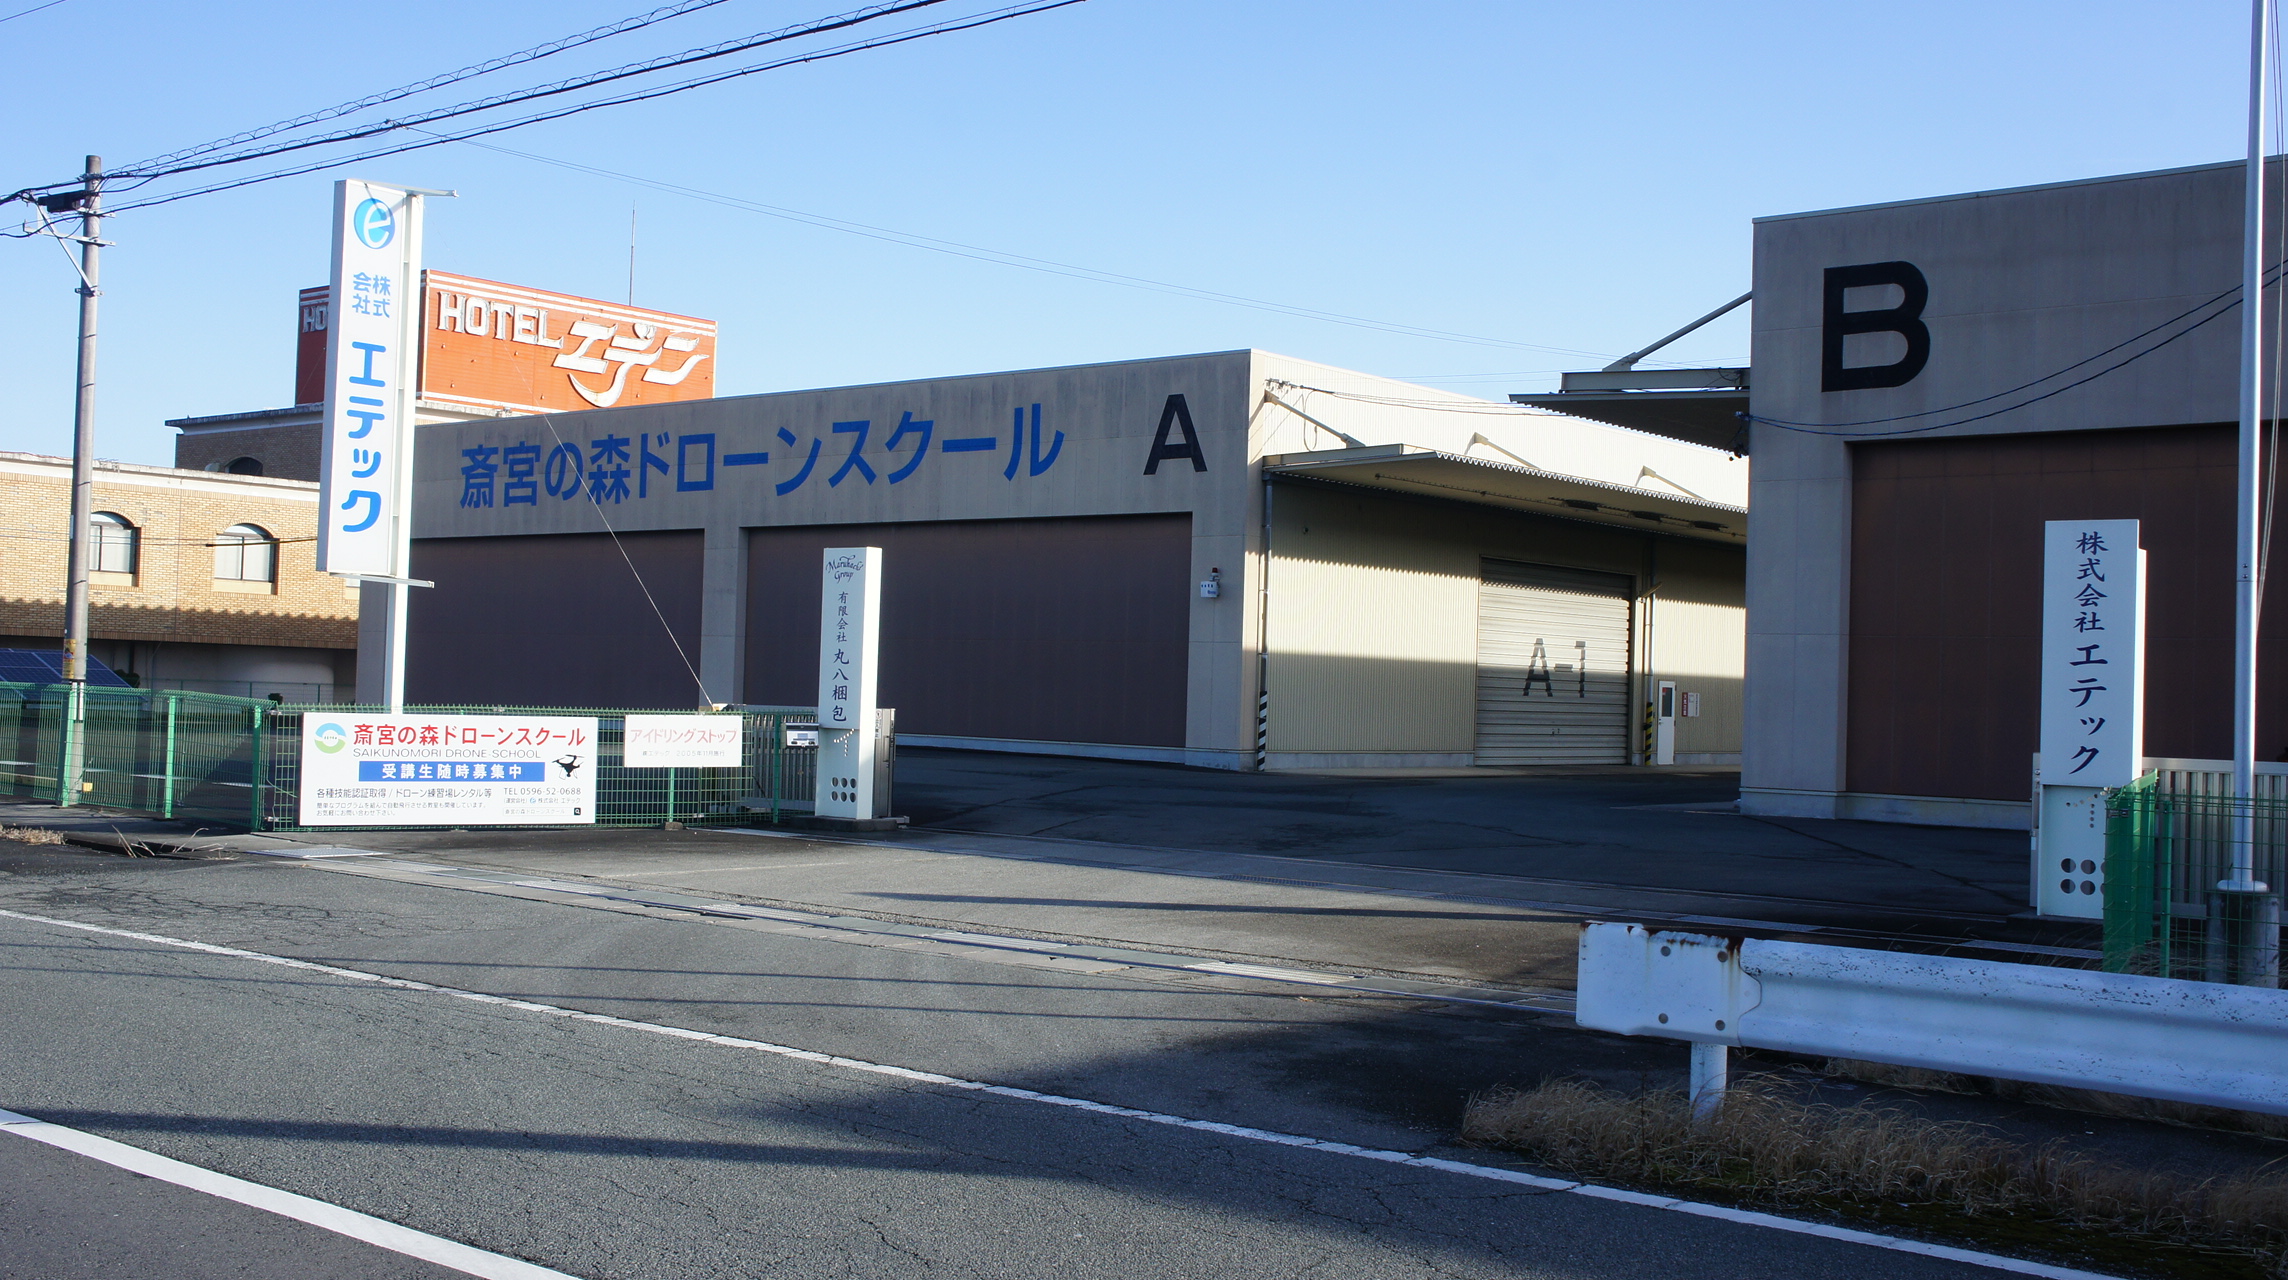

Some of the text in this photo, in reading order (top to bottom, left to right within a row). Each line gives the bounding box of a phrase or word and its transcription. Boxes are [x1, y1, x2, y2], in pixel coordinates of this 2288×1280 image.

[438, 291, 563, 349] HOTEL
[1821, 261, 1930, 392] B
[551, 319, 709, 408] エデン
[341, 341, 386, 533] エテック
[460, 403, 1064, 509] 斎宮の森ドローンスクール
[1143, 393, 1208, 476] A
[834, 570, 854, 584] Group
[832, 591, 850, 722] 有限会社 丸八梱包
[1523, 638, 1586, 697] A-1
[2068, 531, 2109, 775] 株式会社 エテック
[353, 723, 586, 746] 斎宮の森ドローンスクール
[353, 748, 442, 757] SAIKUNOMORI
[630, 727, 738, 744] アイドリングストップ
[317, 788, 386, 799] 各種技能認証取得
[396, 788, 492, 798] ドローン練習場レンタル等
[382, 763, 522, 779] 受講生随時募集中
[503, 787, 581, 795] TEL 0596-52-0688
